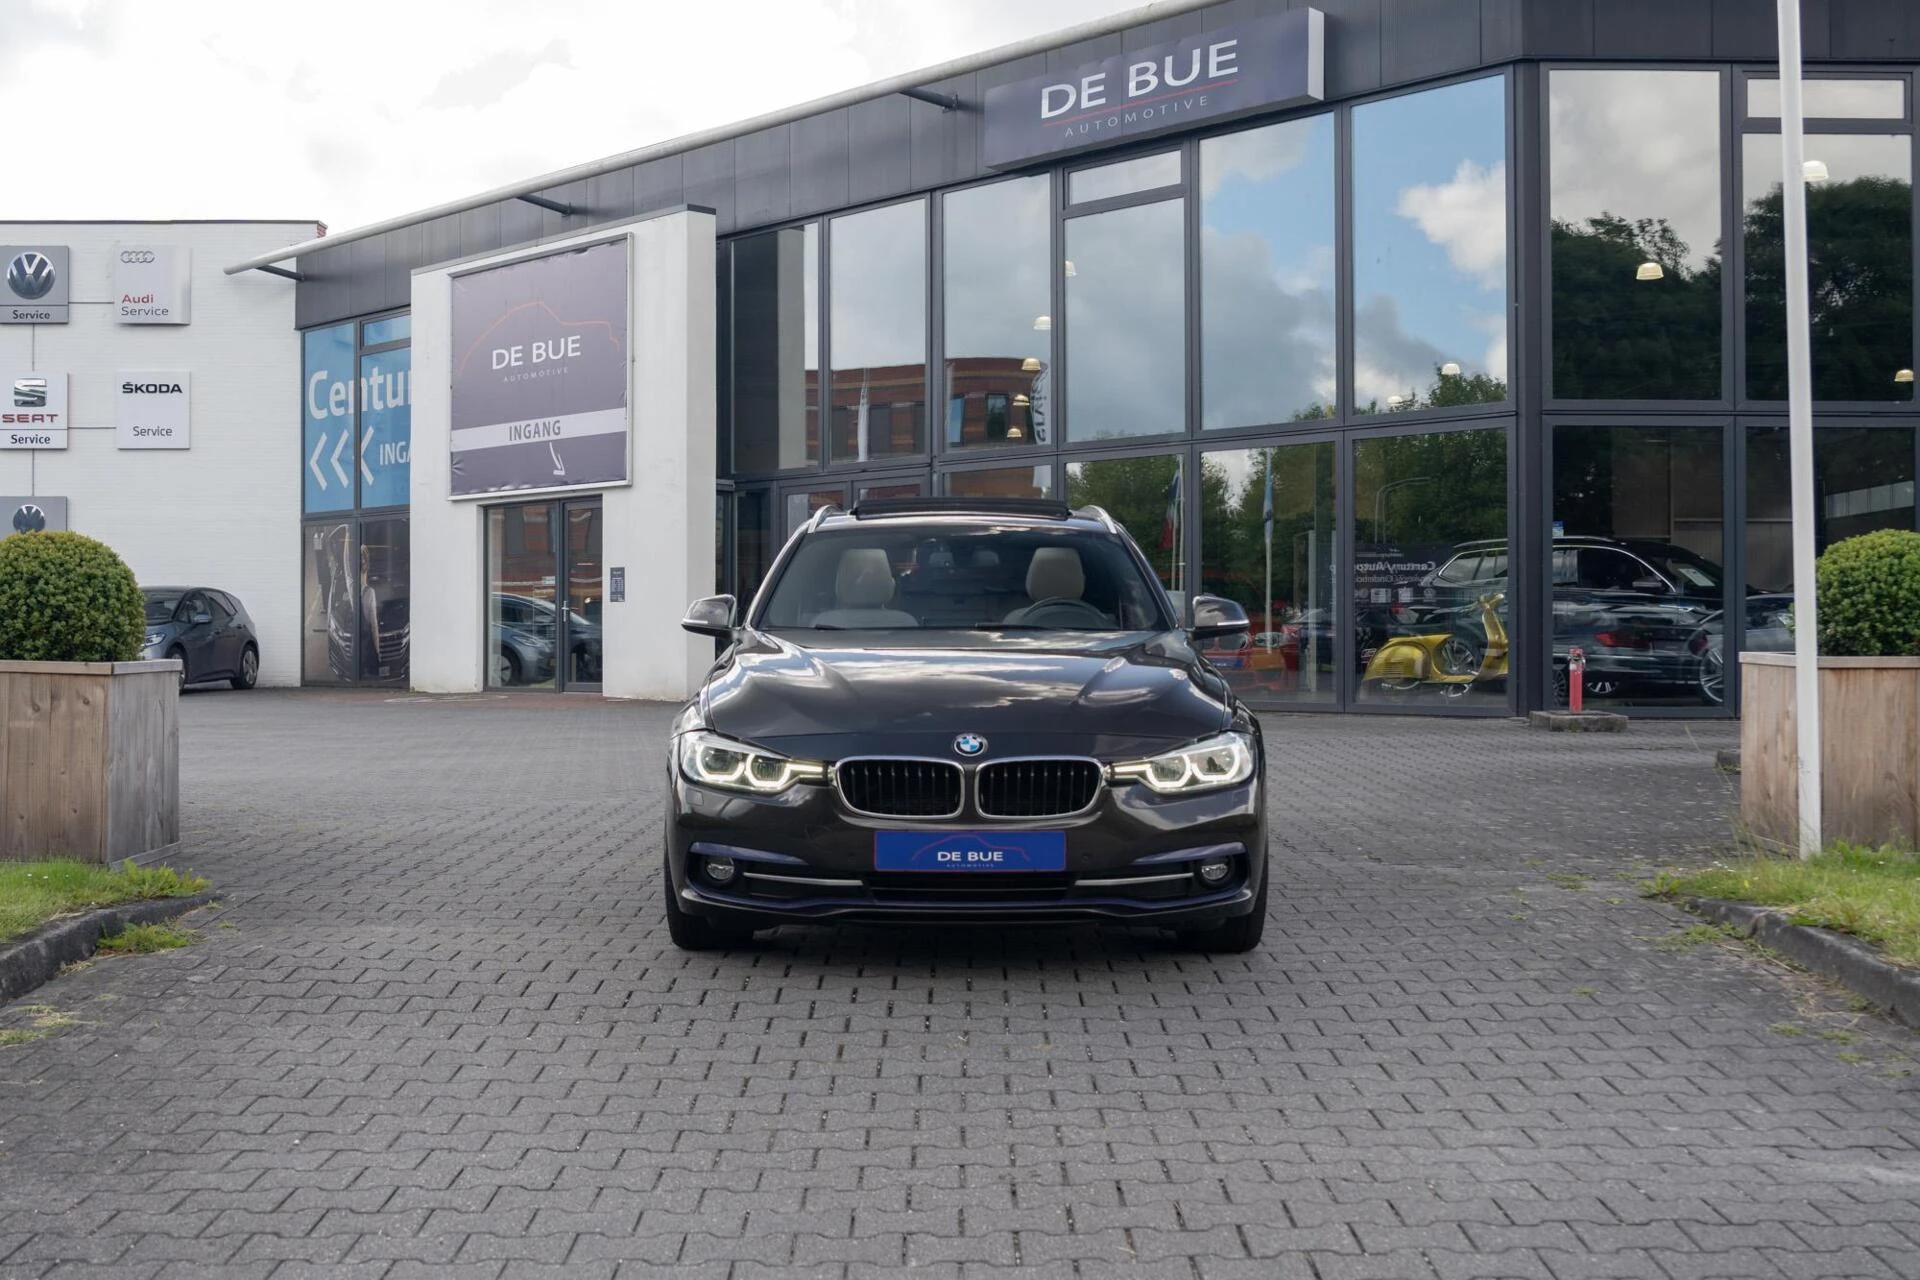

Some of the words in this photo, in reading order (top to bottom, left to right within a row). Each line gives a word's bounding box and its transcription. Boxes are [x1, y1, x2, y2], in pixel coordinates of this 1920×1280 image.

[1041, 72, 1106, 119] DE
[1128, 39, 1238, 98] BUE
[1064, 95, 1208, 138] AUTOMOTIVE
[121, 294, 154, 304] Audi
[12, 309, 51, 320] Service
[121, 306, 169, 316] Service
[492, 345, 523, 370] DE
[532, 335, 581, 363] BUE
[503, 366, 569, 383] AUTOMOTIVE
[122, 381, 183, 394] ŠKODA
[2, 413, 59, 424] SEAT
[132, 425, 173, 437] Service
[508, 420, 561, 441] INGANG
[10, 433, 51, 444] Service
[937, 851, 962, 861] DE
[967, 851, 1004, 861] BUE
